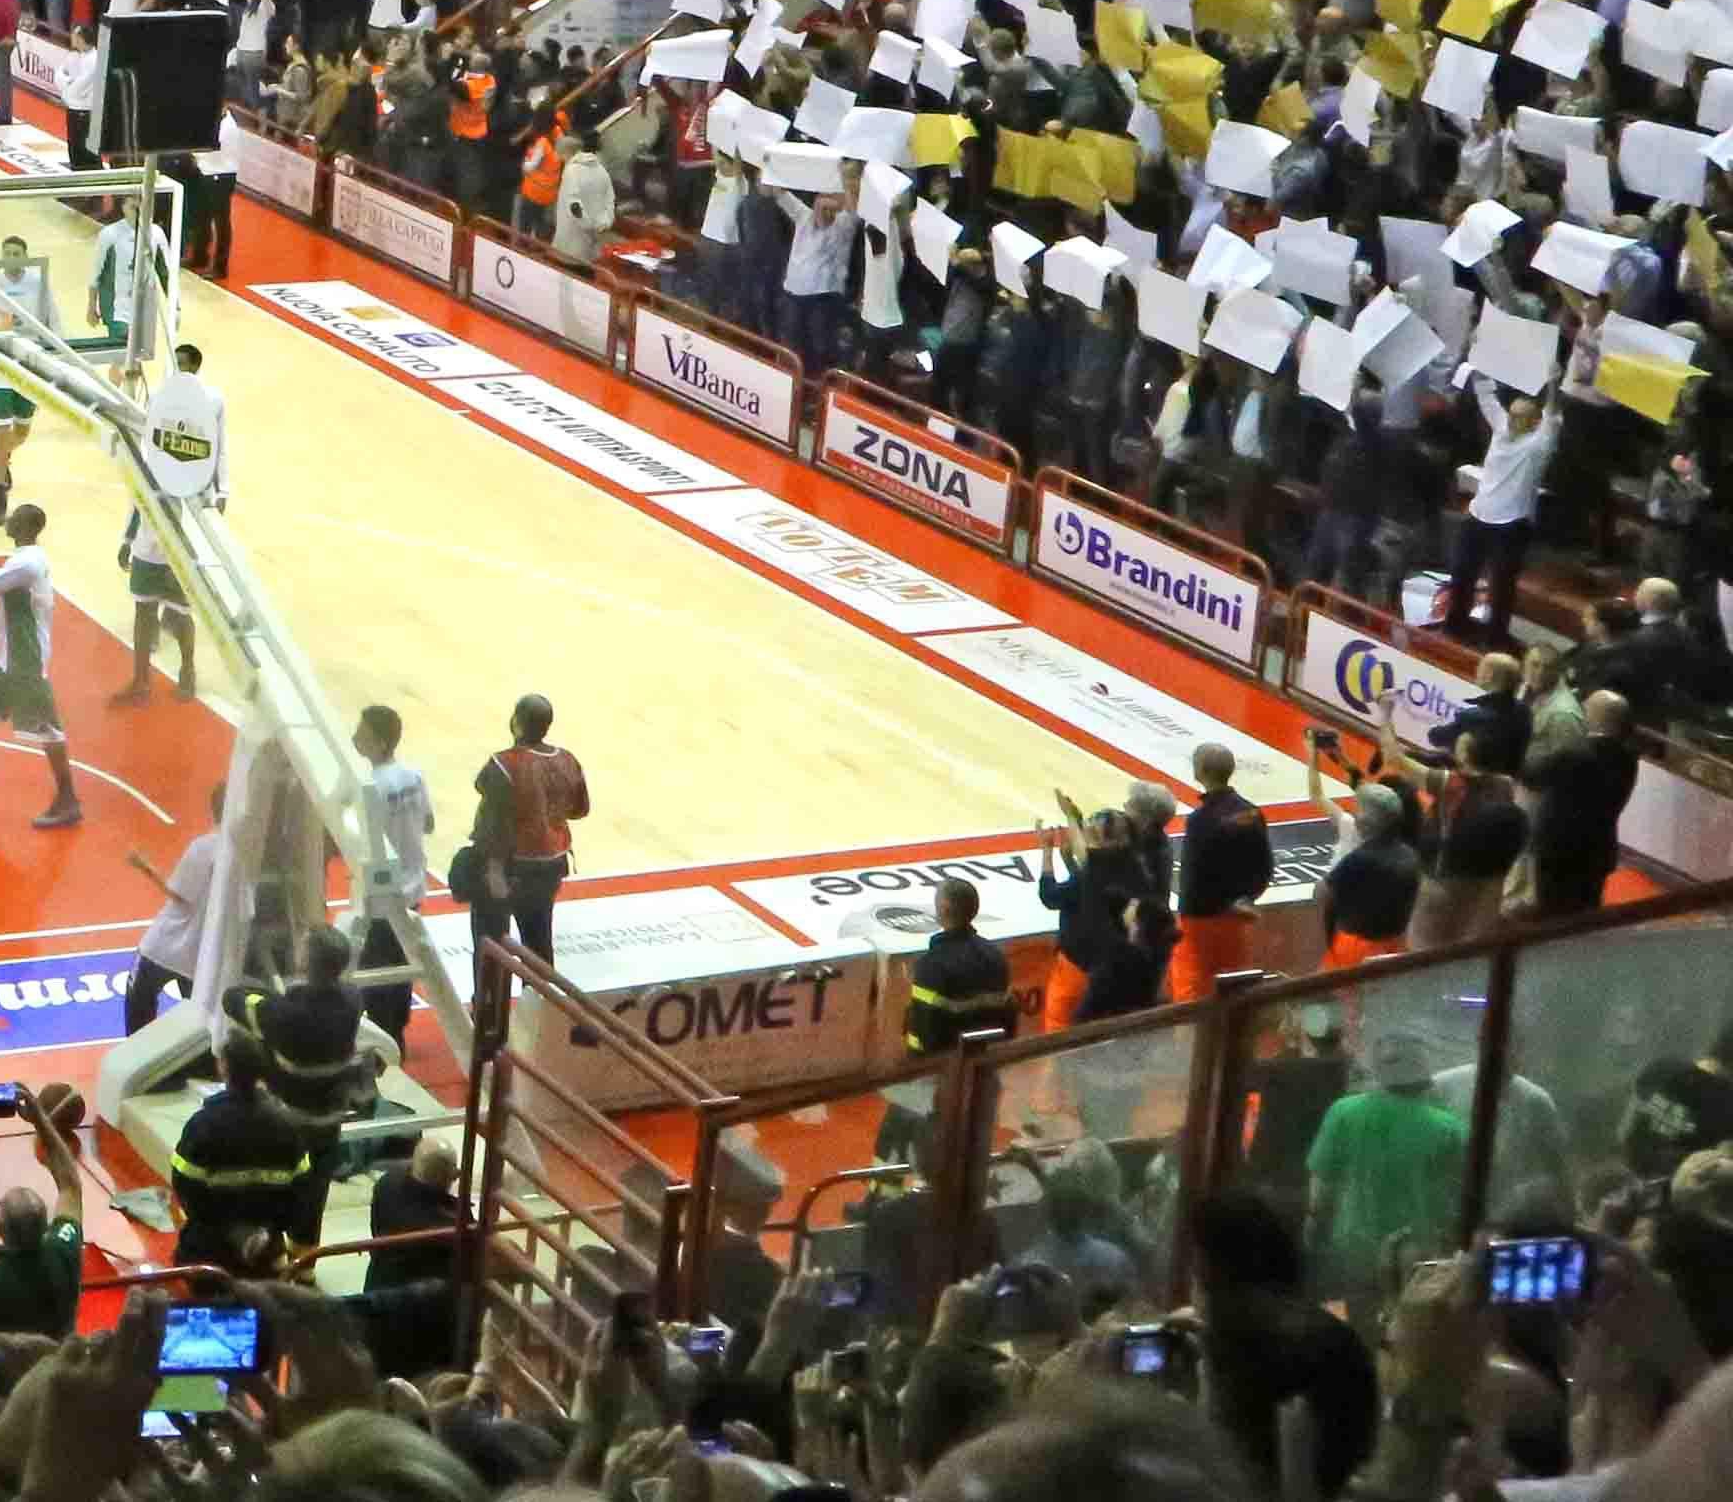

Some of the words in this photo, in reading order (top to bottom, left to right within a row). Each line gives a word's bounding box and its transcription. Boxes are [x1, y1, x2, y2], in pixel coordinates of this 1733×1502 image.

[332, 321, 441, 374] COMAUTO
[852, 425, 971, 508] ZONA
[1086, 525, 1243, 633] Brandini
